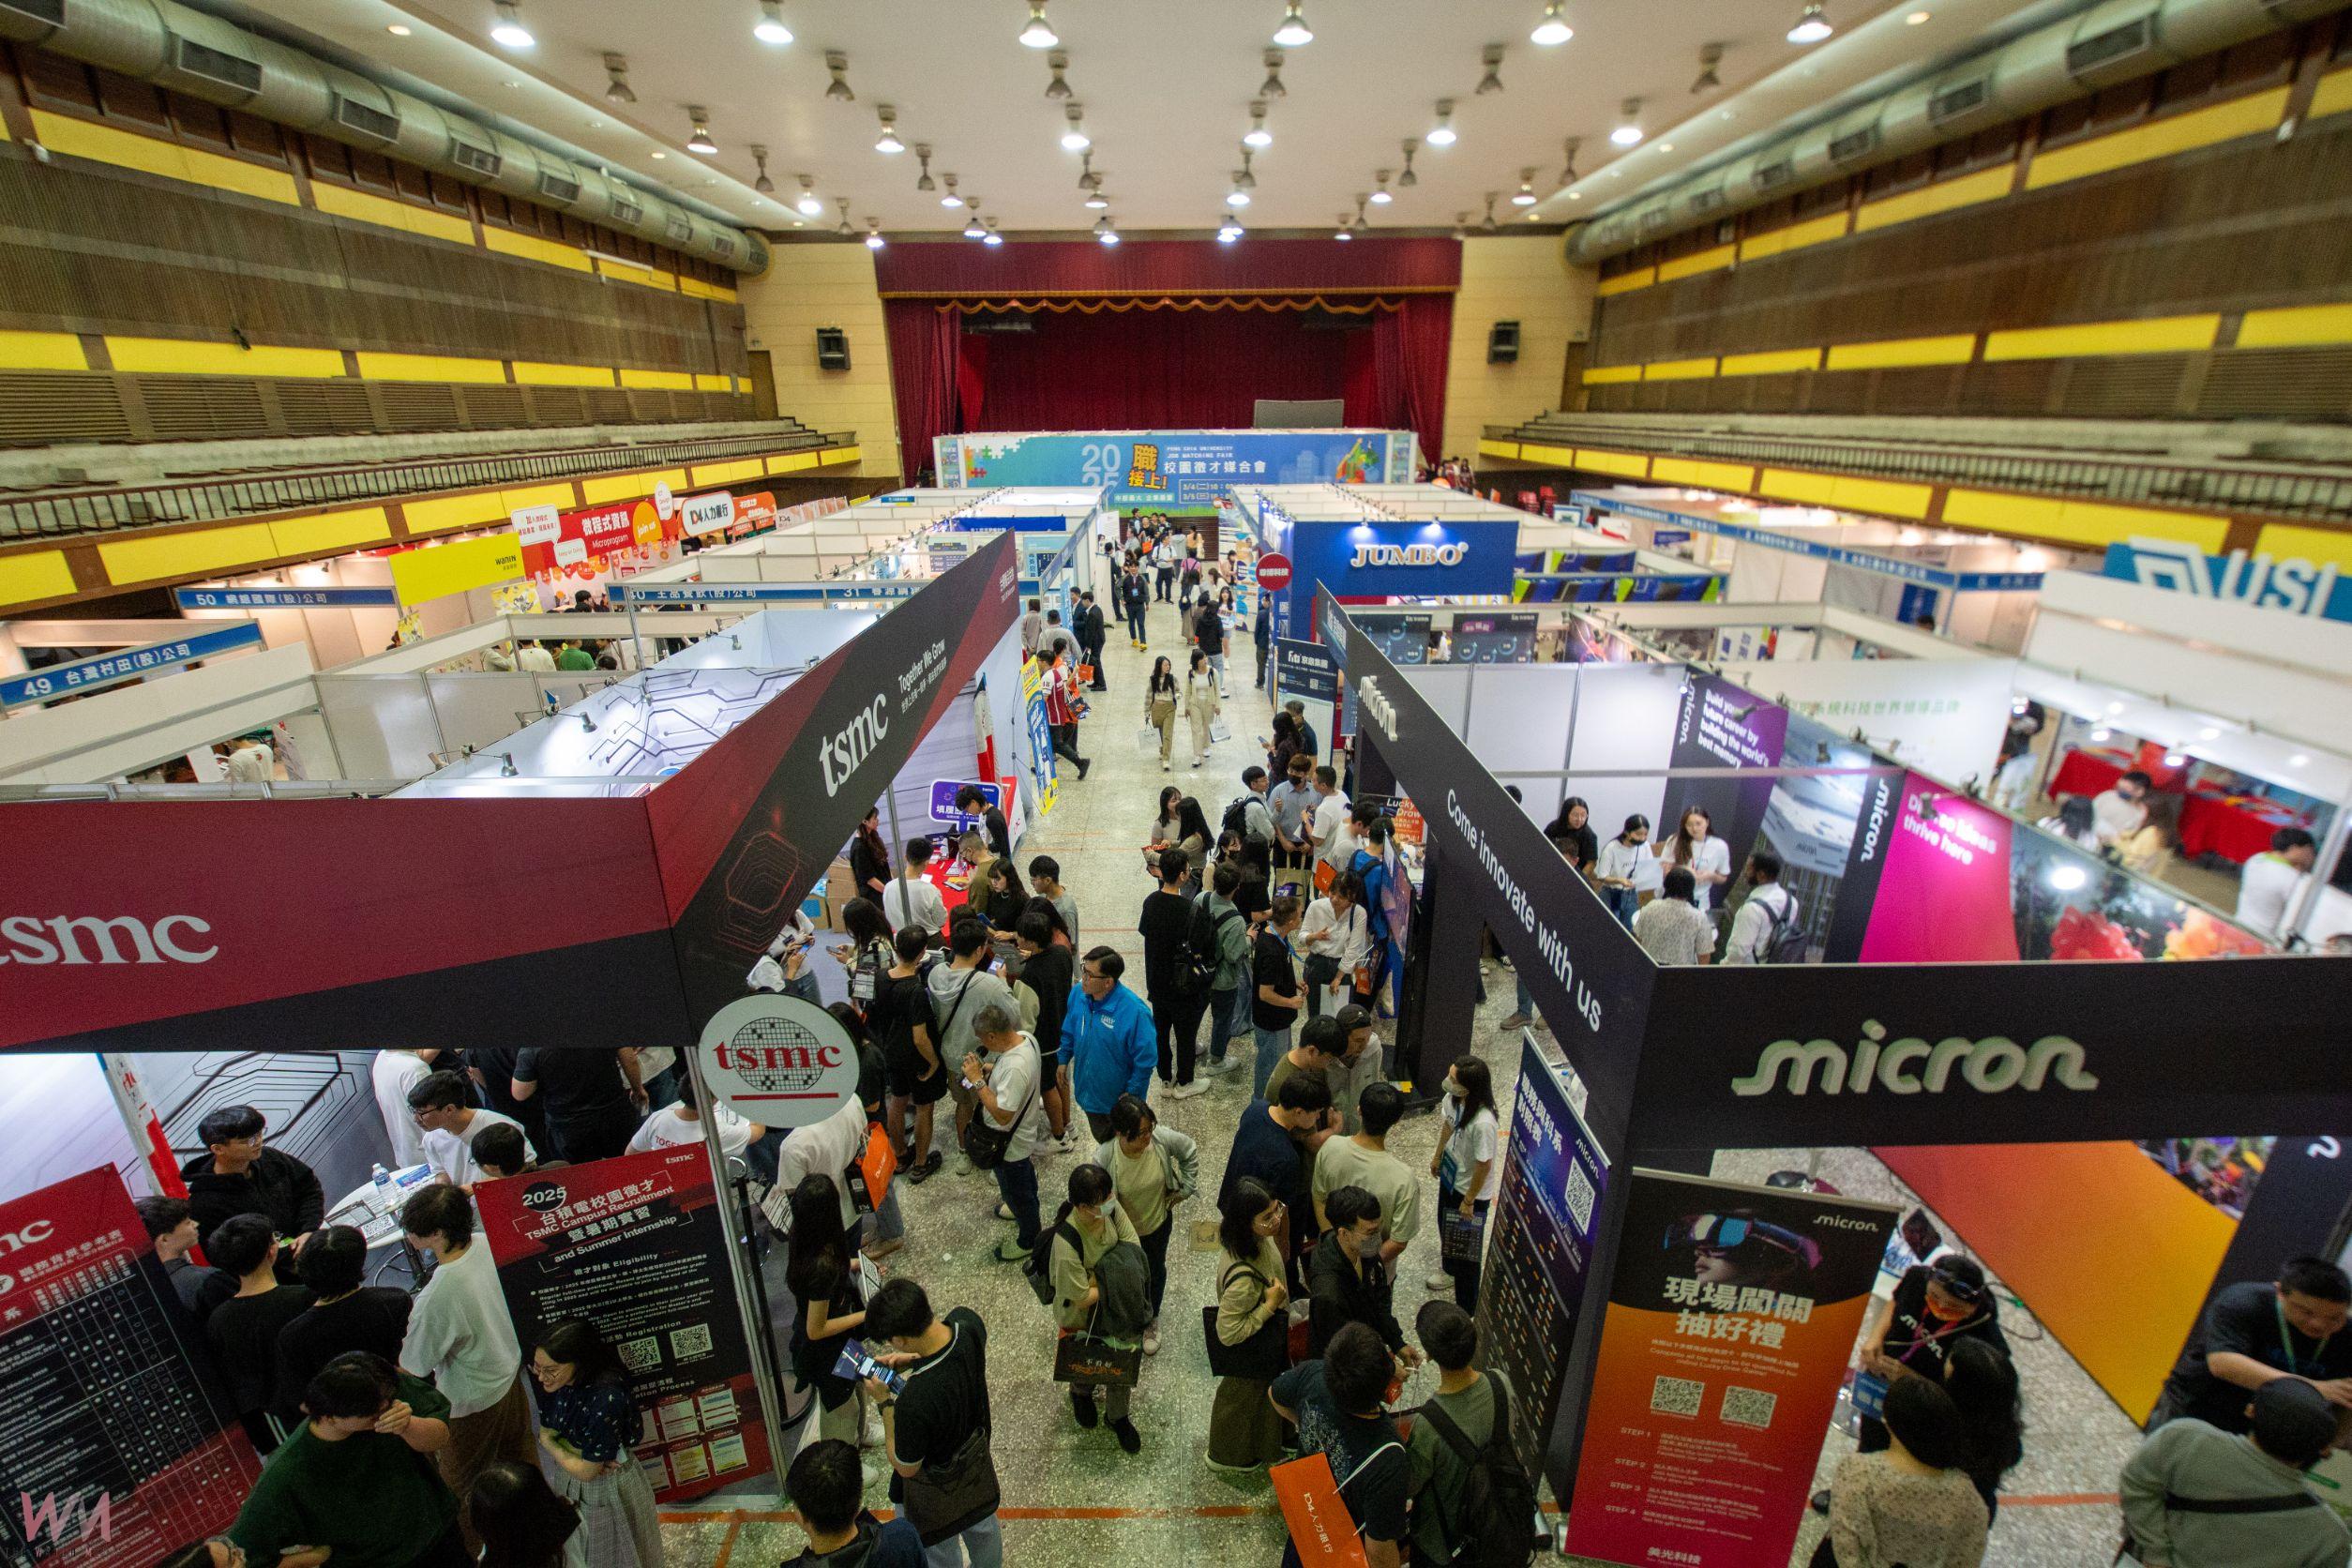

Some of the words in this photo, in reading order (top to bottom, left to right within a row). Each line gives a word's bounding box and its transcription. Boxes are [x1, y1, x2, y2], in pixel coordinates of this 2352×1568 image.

[1081, 445, 1121, 473] 20
[592, 535, 629, 549] Microprogram
[1350, 543, 1464, 567] JUMBO
[195, 594, 217, 606] 50
[2219, 548, 2340, 618] USI
[24, 676, 54, 699] 49
[66, 642, 191, 688] 台灣村田(股)公司
[898, 658, 924, 694] Together
[922, 649, 933, 669] We
[931, 639, 945, 660] Grow
[1358, 675, 1398, 742] micron
[1703, 702, 1724, 724] future
[1724, 717, 1747, 739] career
[1747, 728, 1759, 747] by
[819, 692, 890, 797] tsmc
[1697, 731, 1714, 751] best
[1700, 716, 1728, 746] building
[1728, 732, 1741, 751] the
[1387, 797, 1415, 811] Lucky
[1861, 777, 1891, 863] micron
[1903, 814, 1940, 846] thrive
[1940, 834, 1974, 865] here
[1447, 789, 1477, 849] Come
[1479, 830, 1535, 933] innovate
[1538, 921, 1573, 993] with
[1576, 979, 1602, 1033] us
[713, 1041, 843, 1070] tsmc
[1731, 1018, 2100, 1096] micron
[666, 1153, 695, 1165] tsmc
[1576, 1138, 1600, 1180] micron
[522, 1185, 567, 1207] 2025
[525, 1224, 561, 1241] TSMC
[561, 1209, 608, 1231] Campus
[609, 1185, 675, 1214] Recruitment
[540, 1179, 655, 1227] 台積電校園徵才
[554, 1250, 576, 1264] and
[576, 1233, 623, 1255] Summer
[624, 1215, 677, 1239] Internship
[567, 1206, 651, 1244] 暨暑期實習
[1813, 1214, 1879, 1233] micron
[612, 1252, 658, 1267] Eligibility
[1664, 1275, 1815, 1324] 現場闖關
[626, 1320, 682, 1338] Registration
[1676, 1308, 1787, 1350] 抽好禮
[1621, 1426, 1645, 1437] STEP
[1614, 1457, 1638, 1468] STEP
[1609, 1481, 1634, 1490] STEP
[1605, 1504, 1628, 1514] STEP
